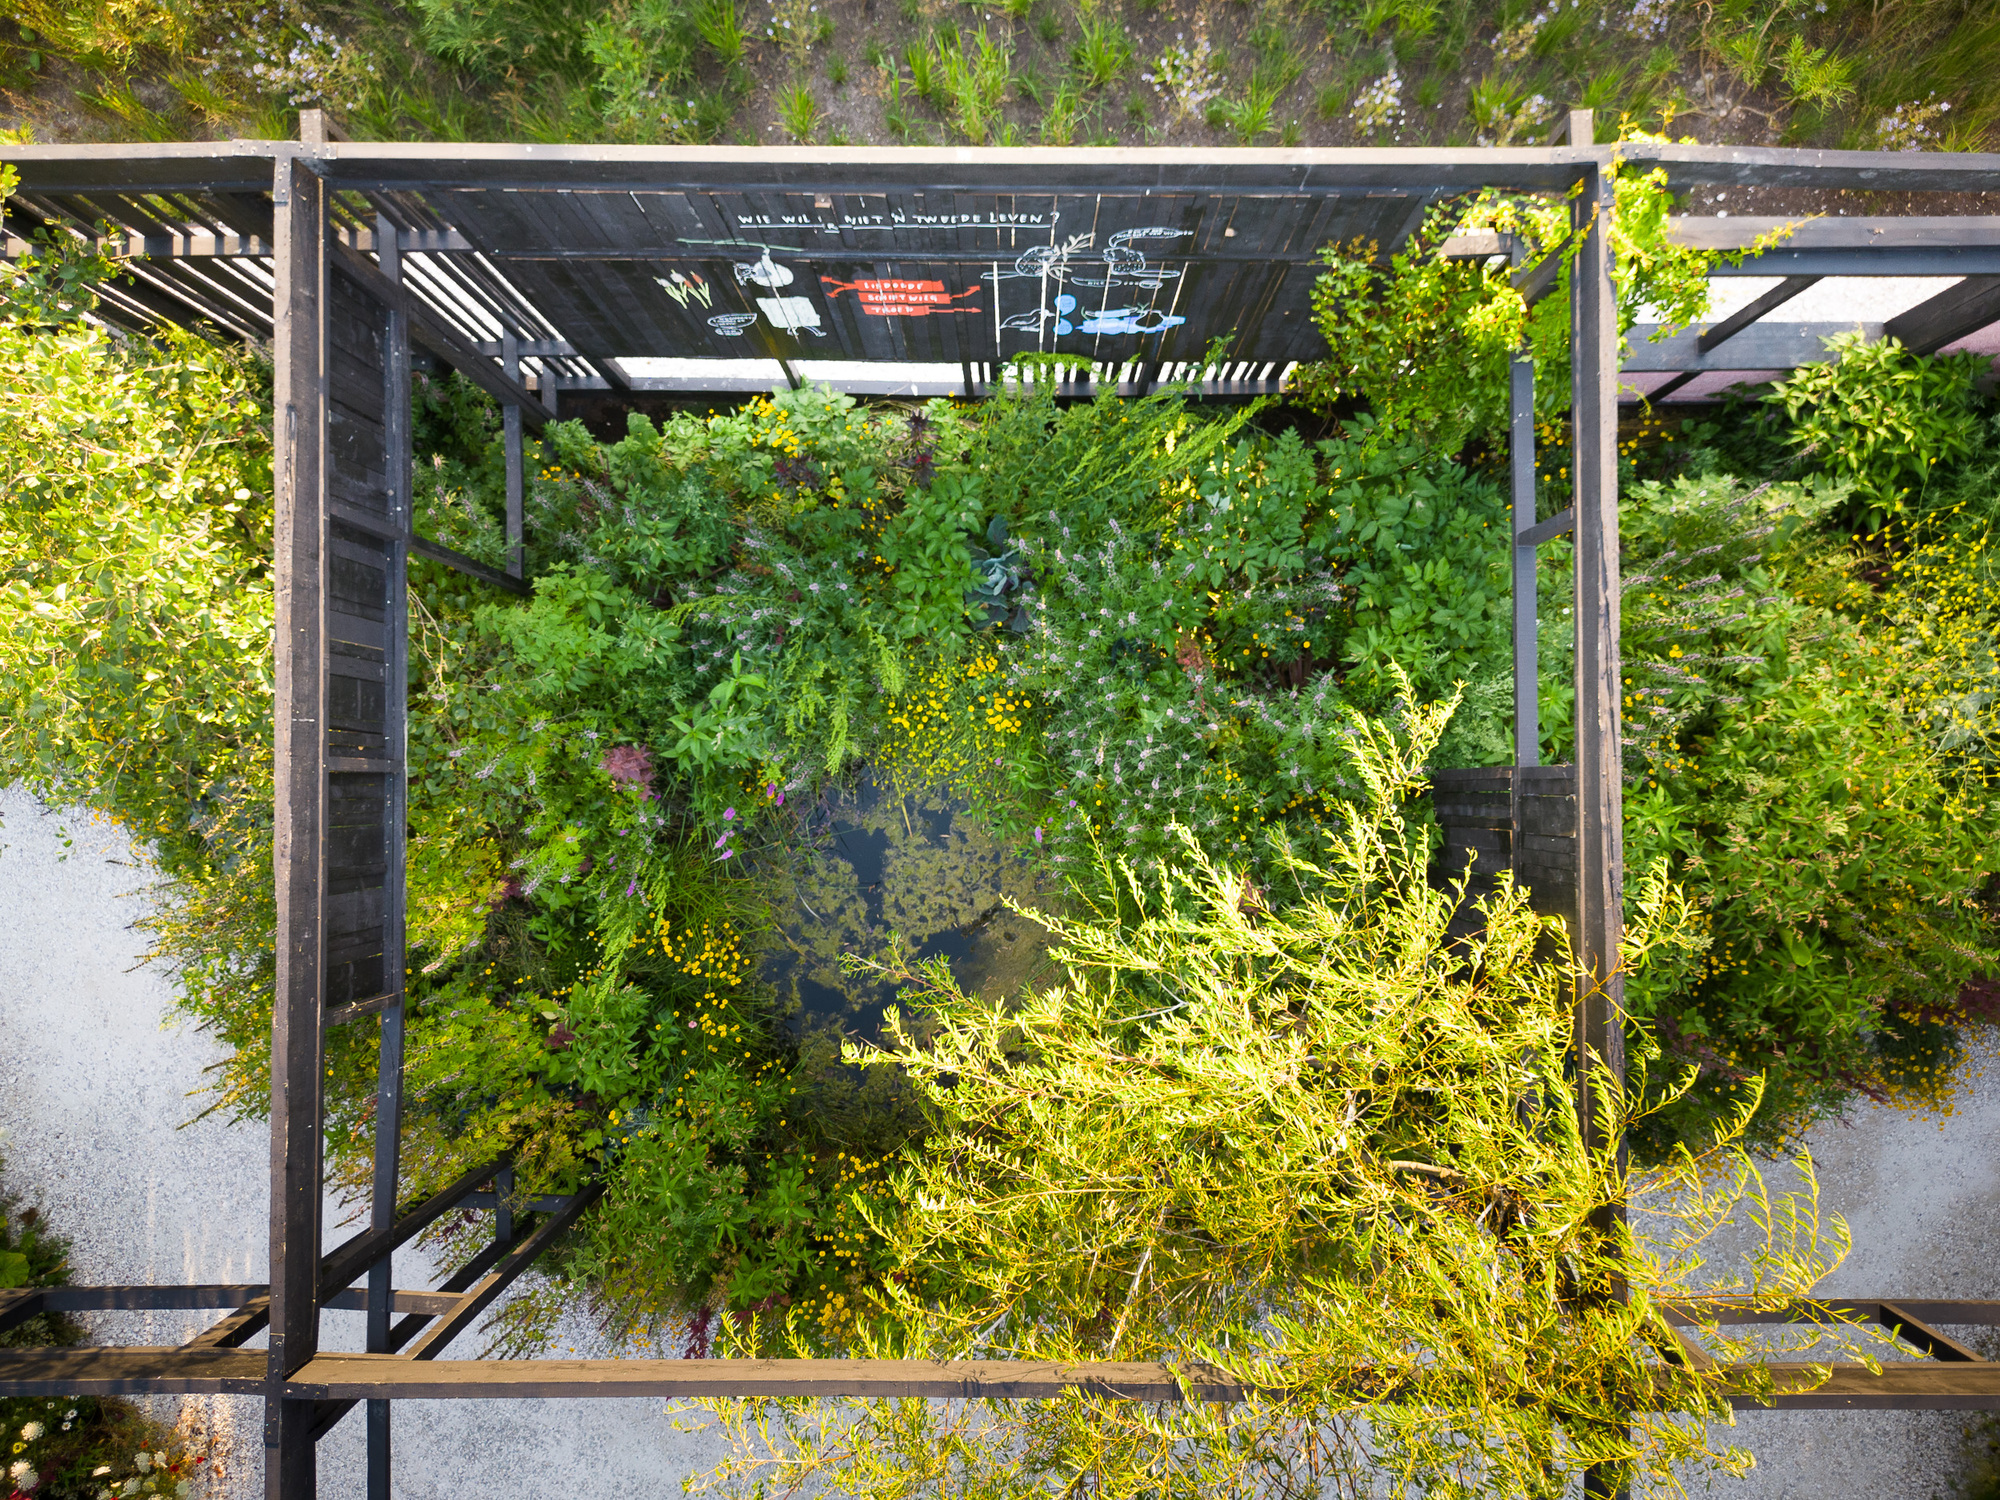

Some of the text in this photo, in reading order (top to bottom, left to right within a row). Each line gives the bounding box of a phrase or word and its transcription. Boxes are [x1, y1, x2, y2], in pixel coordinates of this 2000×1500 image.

[737, 214, 771, 224] WIE
[781, 213, 811, 224] WIL
[844, 214, 884, 226] NIET
[911, 214, 982, 224] TWEEDE
